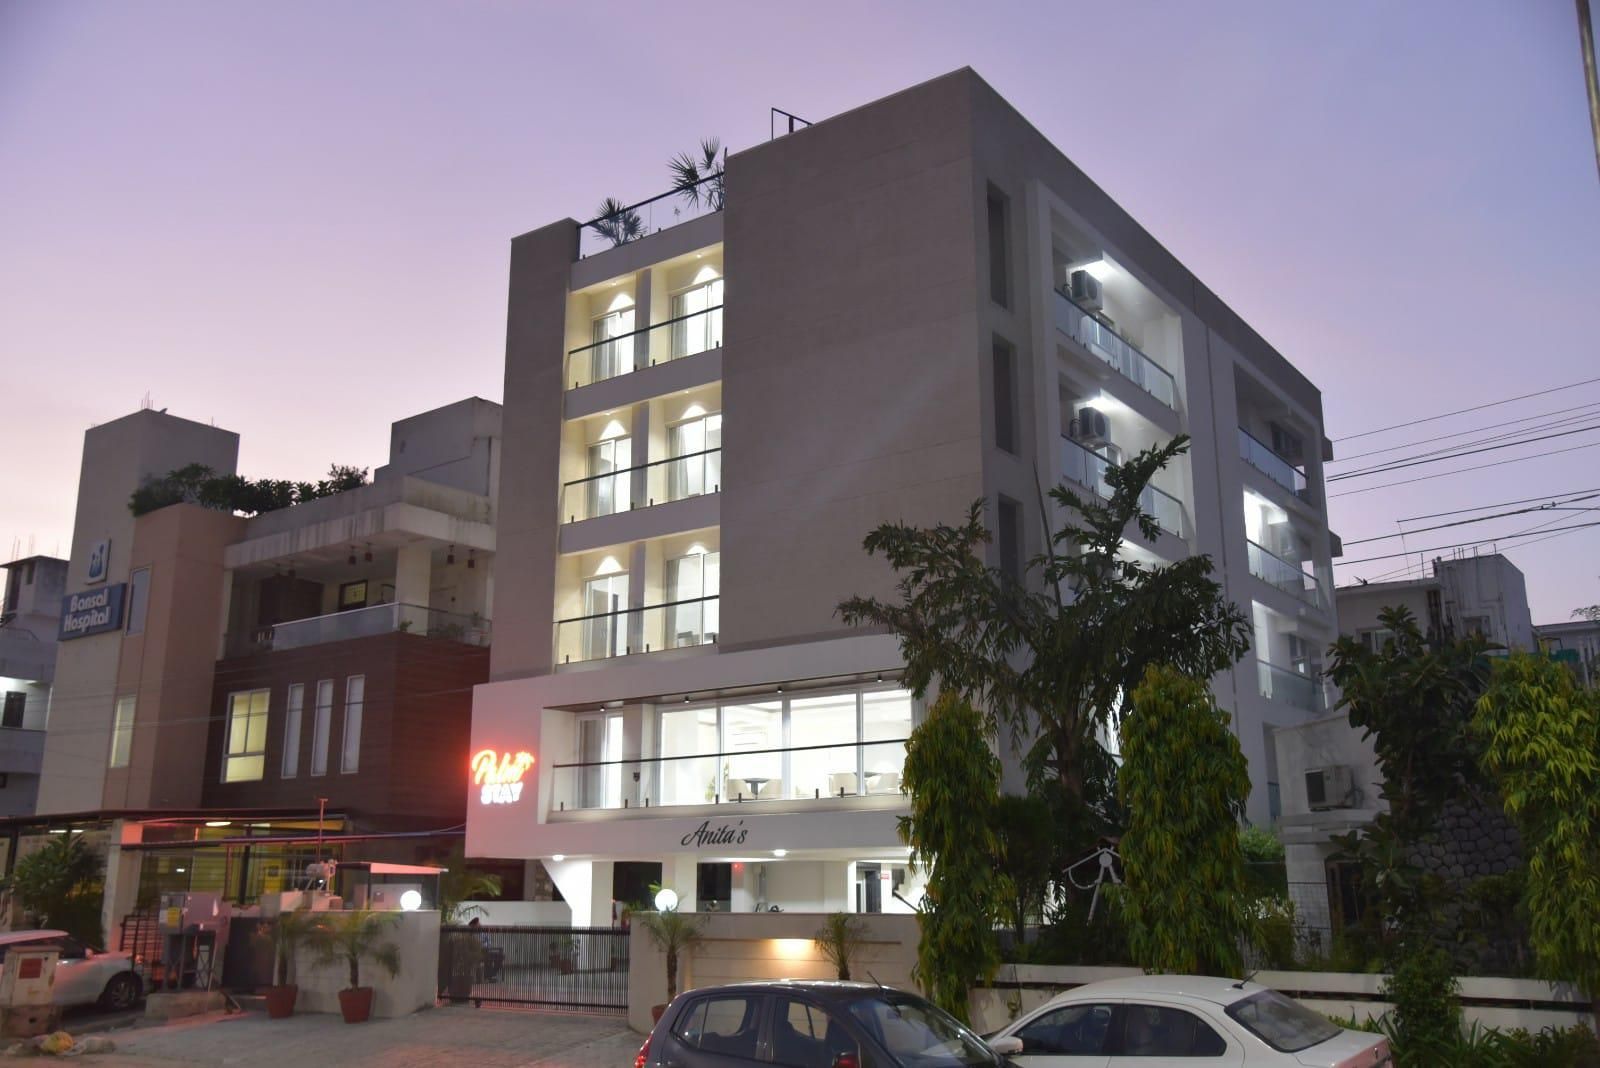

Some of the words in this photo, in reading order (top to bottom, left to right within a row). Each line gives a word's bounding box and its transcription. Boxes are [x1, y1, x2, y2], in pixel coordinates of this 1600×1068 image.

[70, 588, 109, 612] Bansal
[63, 606, 111, 632] Hospital
[481, 782, 523, 805] STAY
[681, 819, 748, 848] Anita's
